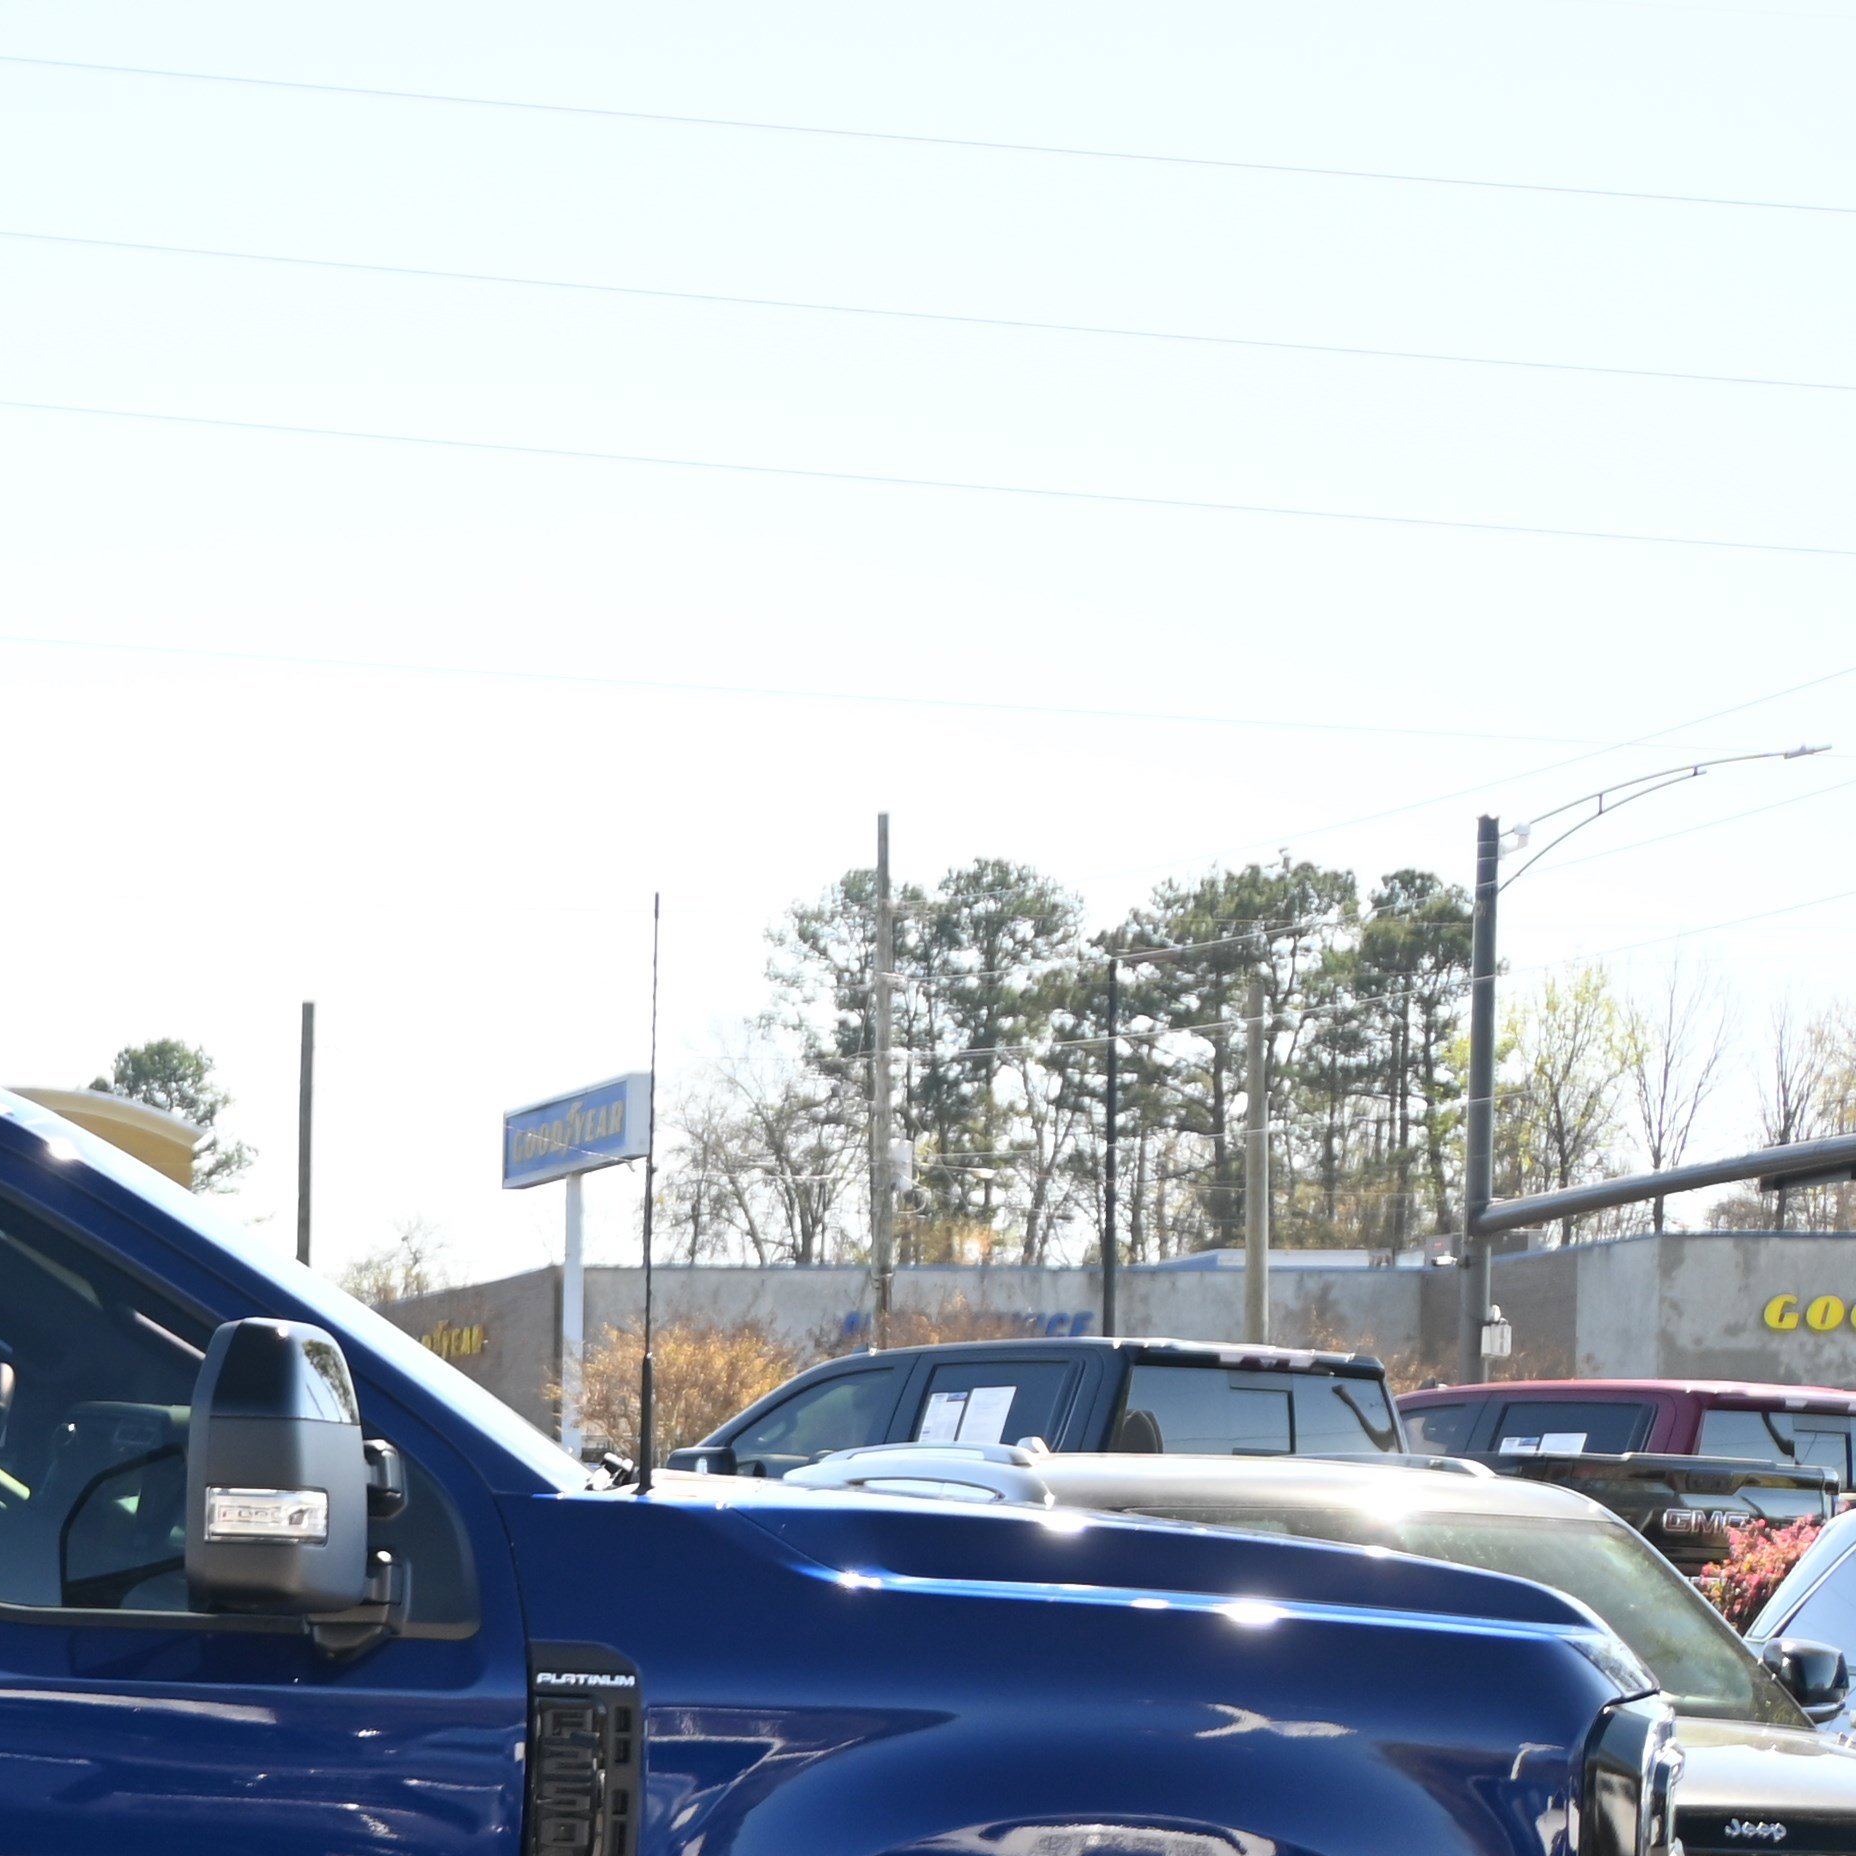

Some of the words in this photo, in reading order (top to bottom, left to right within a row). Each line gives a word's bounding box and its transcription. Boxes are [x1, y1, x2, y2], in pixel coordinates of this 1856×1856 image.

[513, 1099, 626, 1165] GOODYEAR
[1763, 1293, 1856, 1331] GO
[1663, 1508, 1750, 1534] GMC
[536, 1671, 636, 1688] PLATINUM
[1724, 1818, 1787, 1843] Jeep
